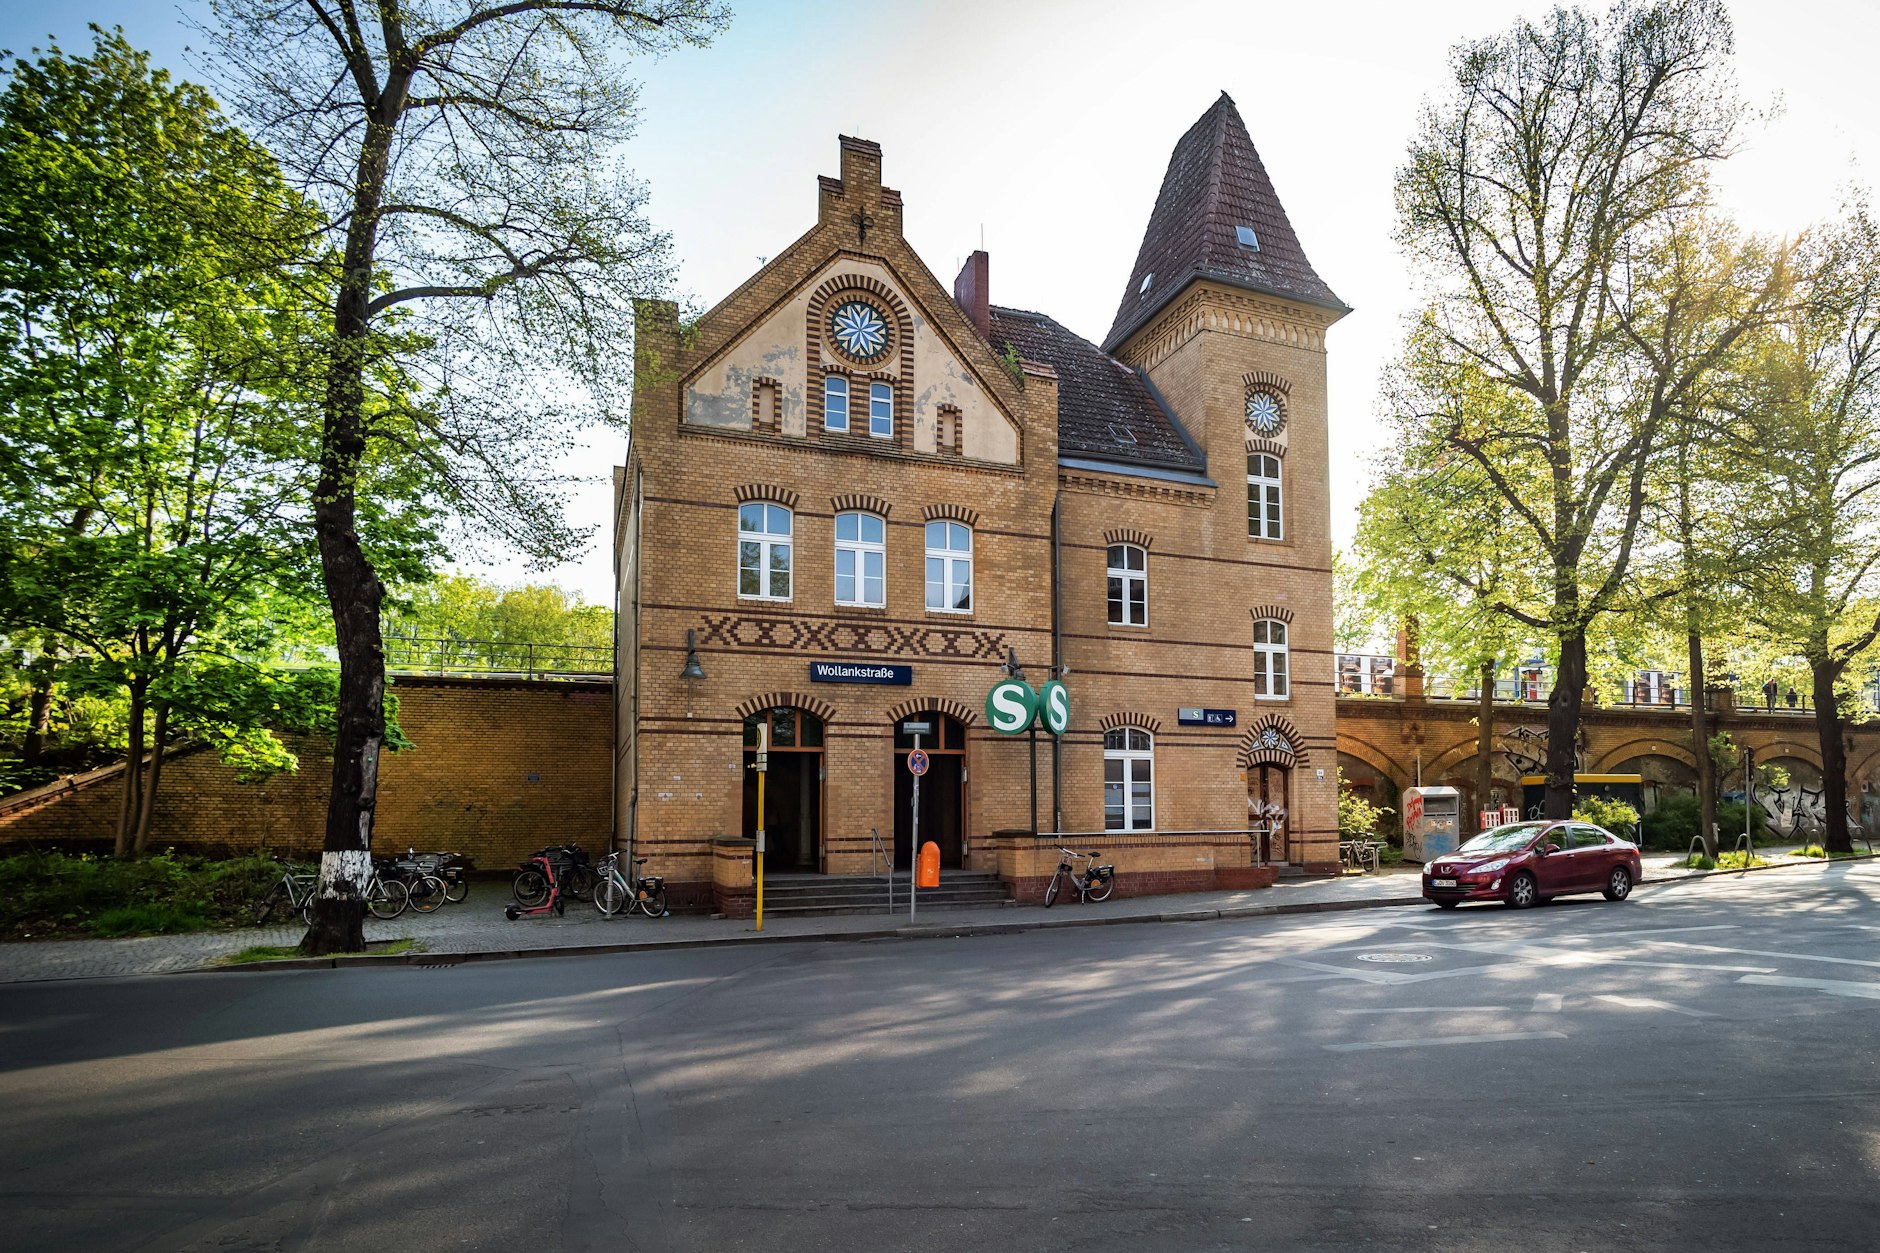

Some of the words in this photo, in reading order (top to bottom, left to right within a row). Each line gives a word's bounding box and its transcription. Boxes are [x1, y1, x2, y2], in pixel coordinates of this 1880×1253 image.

[817, 664, 894, 679] Wollankstraße
[992, 684, 1027, 731] S
[1050, 684, 1067, 731] S
[1192, 710, 1199, 718] S
